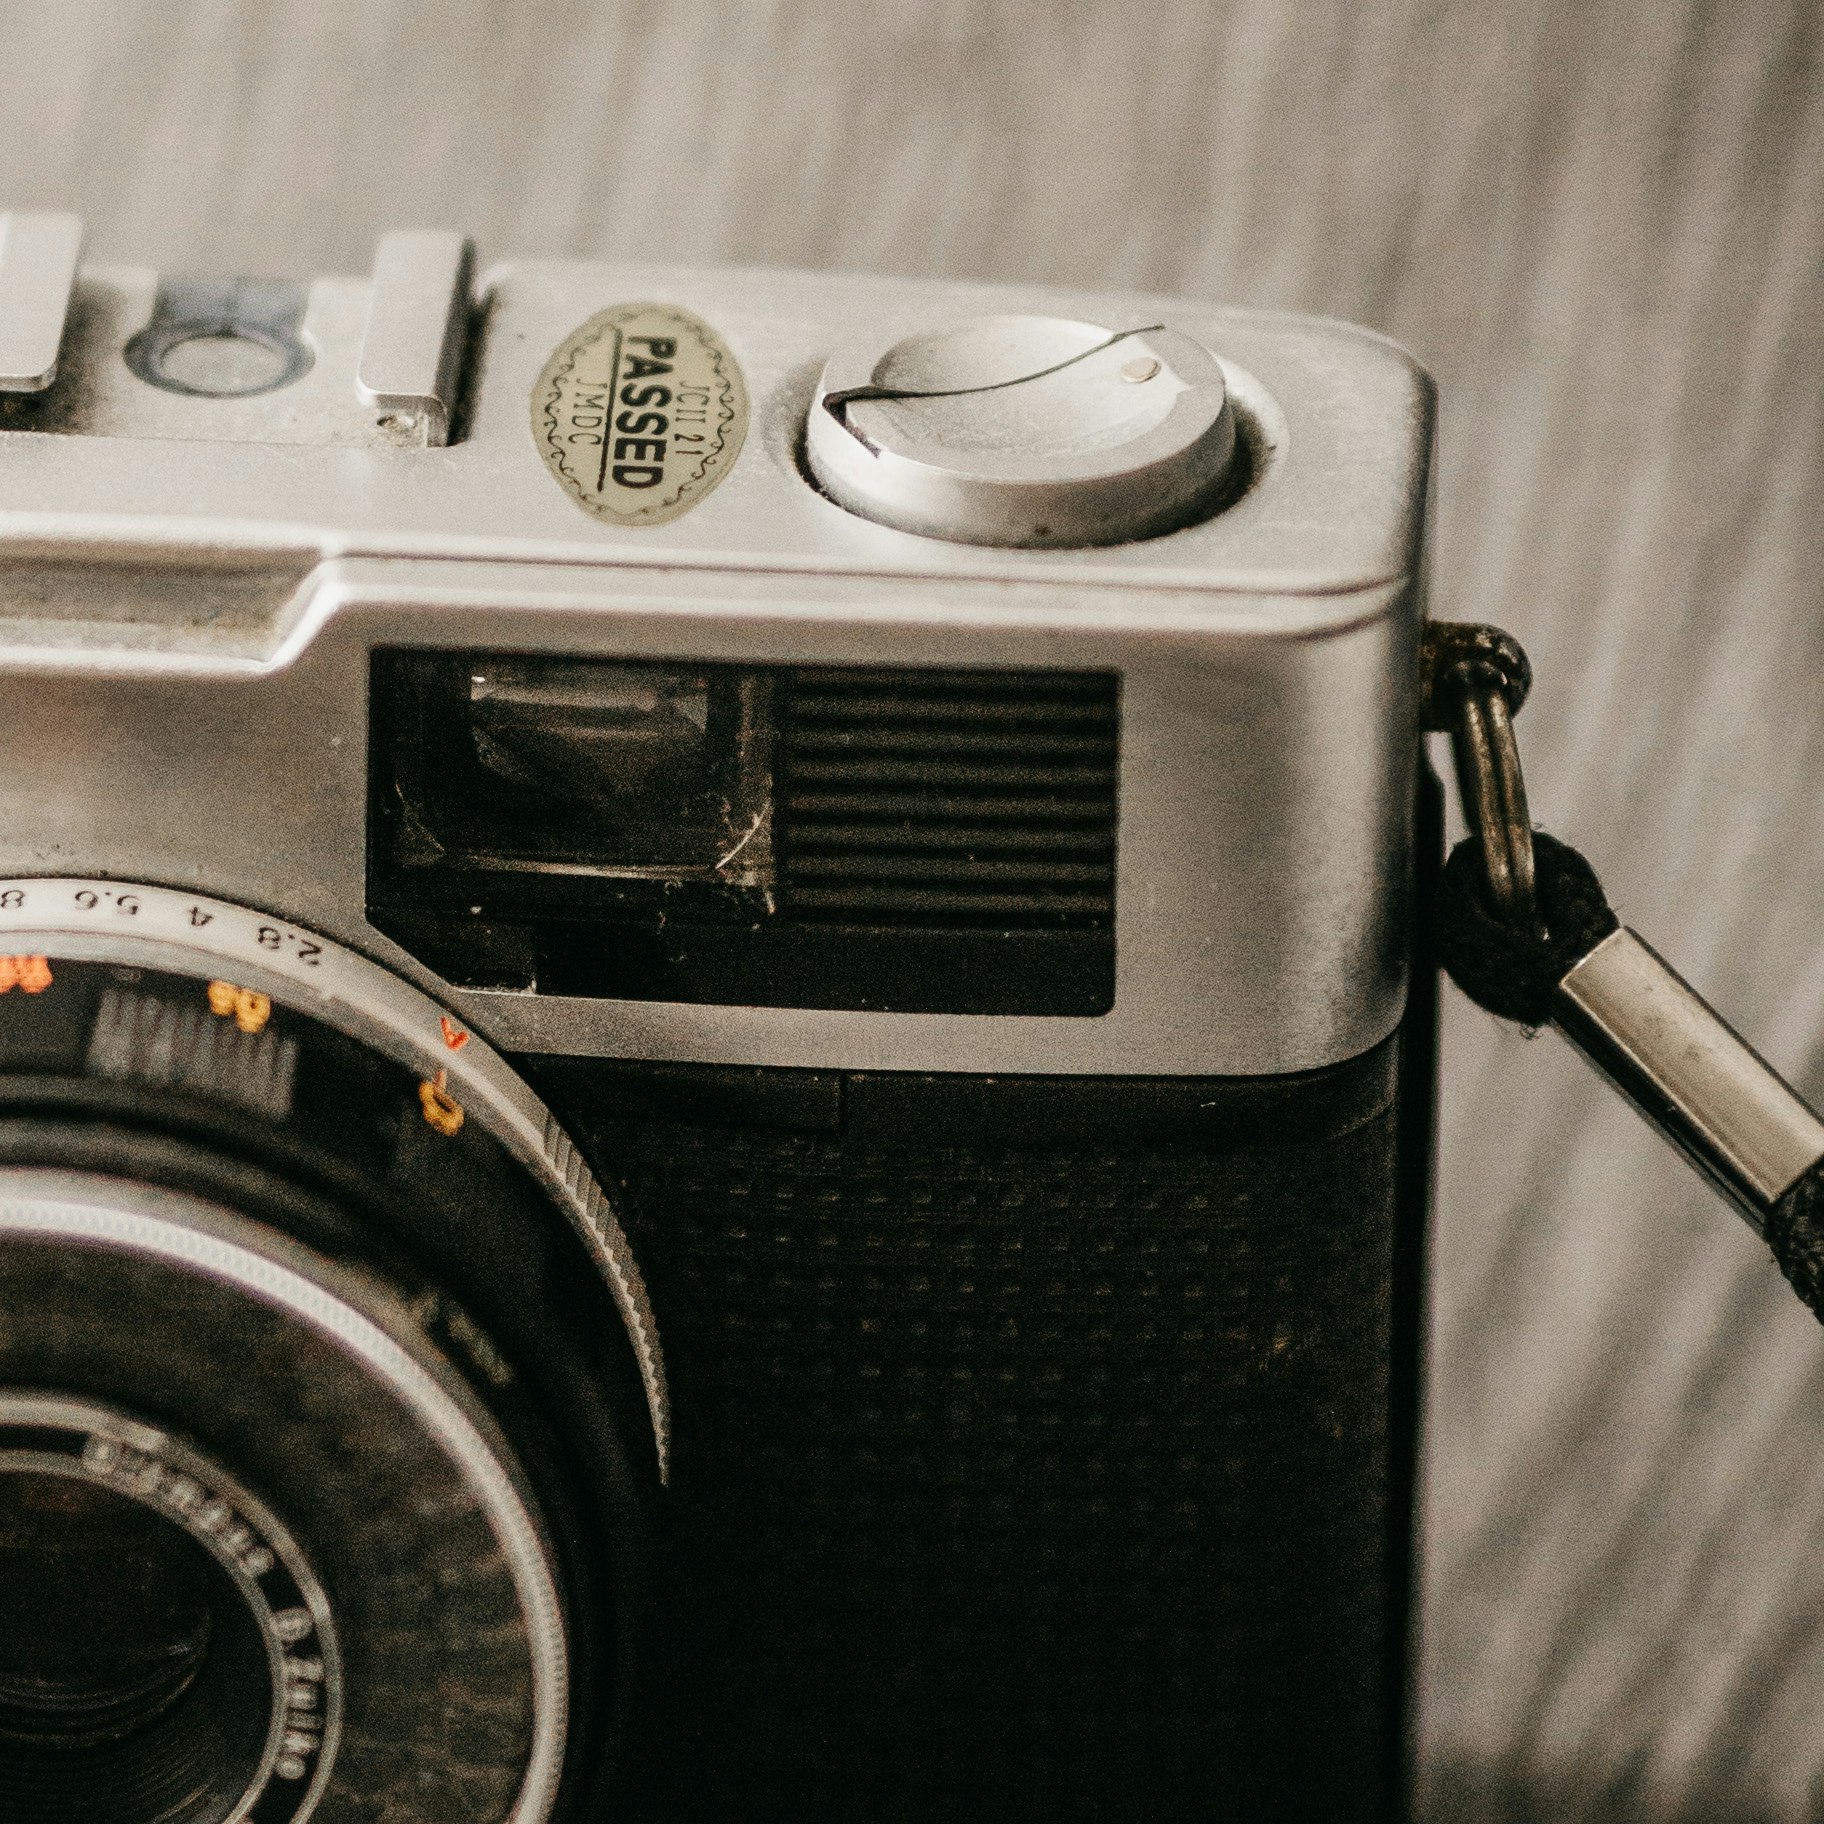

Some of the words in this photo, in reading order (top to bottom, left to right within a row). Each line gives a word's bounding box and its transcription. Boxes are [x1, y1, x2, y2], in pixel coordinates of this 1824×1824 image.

[568, 378, 608, 445] JMDC
[612, 336, 677, 490] PASSED
[675, 380, 710, 424] JCII
[0, 889, 27, 910] 8
[74, 889, 140, 917] 5.6
[186, 905, 215, 928] 4
[257, 924, 324, 967] 2.8
